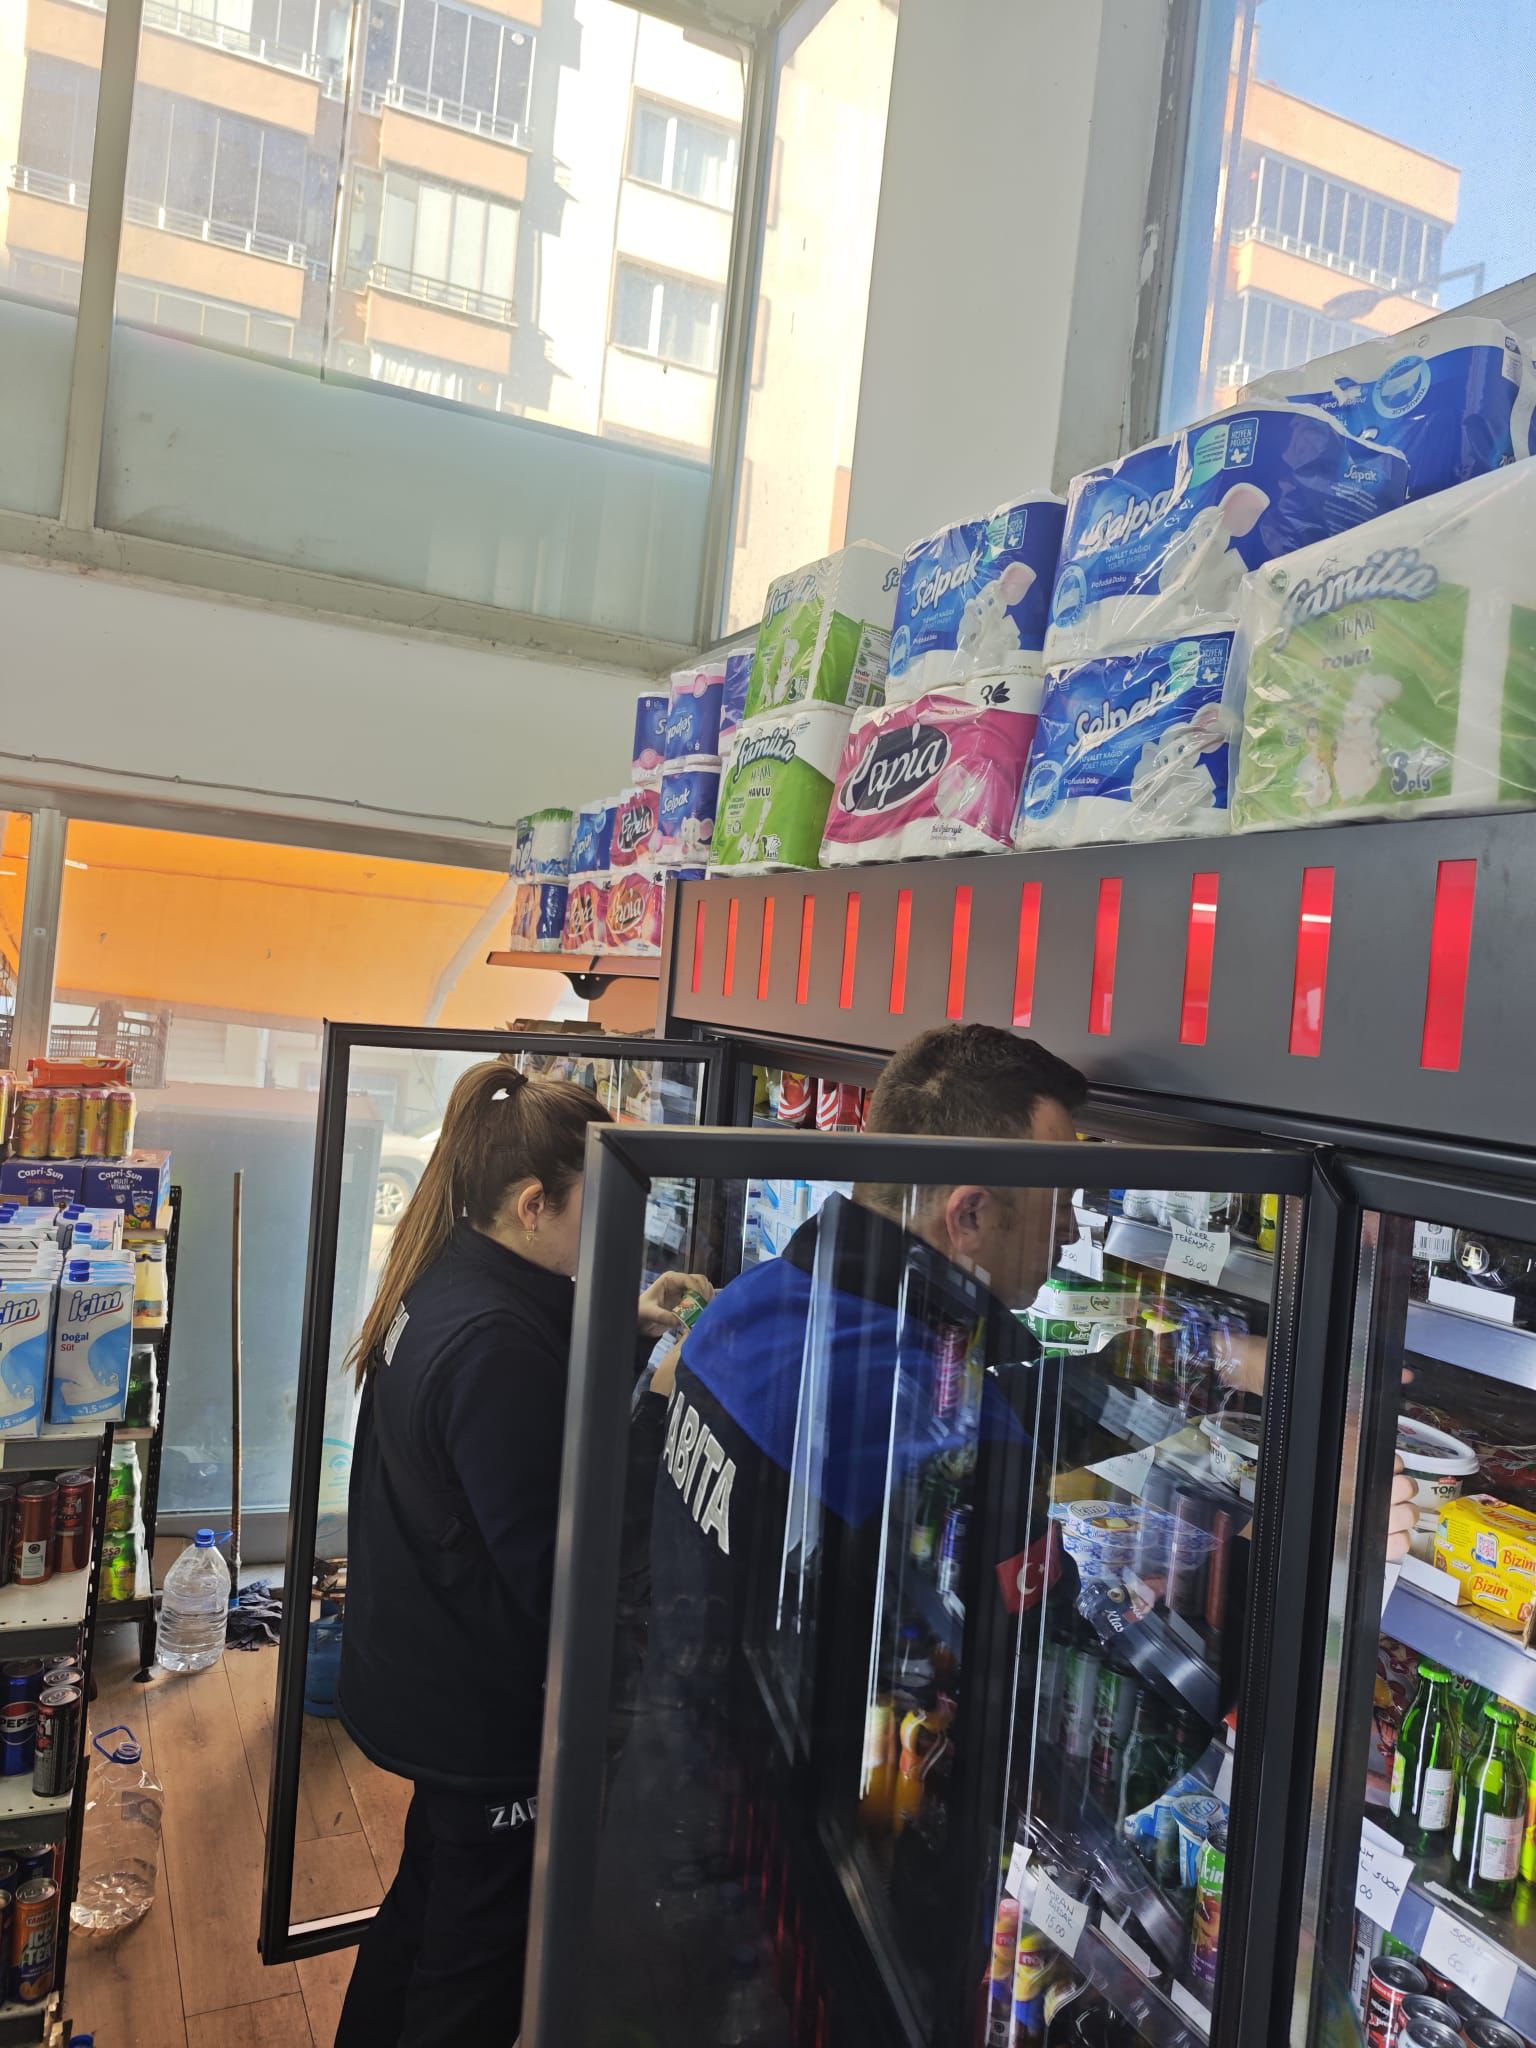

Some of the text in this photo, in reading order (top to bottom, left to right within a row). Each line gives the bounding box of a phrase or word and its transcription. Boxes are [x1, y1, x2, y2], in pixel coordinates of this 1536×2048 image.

[911, 550, 983, 618] Selpak
[732, 726, 797, 785] familia
[840, 721, 945, 813] Papia
[1408, 773, 1431, 792] ply
[662, 787, 691, 814] Selpak
[17, 1167, 64, 1180] Capri-Sun
[98, 1170, 143, 1182] Capri-Sun
[68, 1290, 122, 1323] İçim
[60, 1343, 75, 1352] Süt
[61, 1332, 90, 1344] Doğal
[662, 1388, 738, 1557] ABITA
[1472, 1575, 1509, 1601] Bizim
[28, 1926, 50, 1946] ICE
